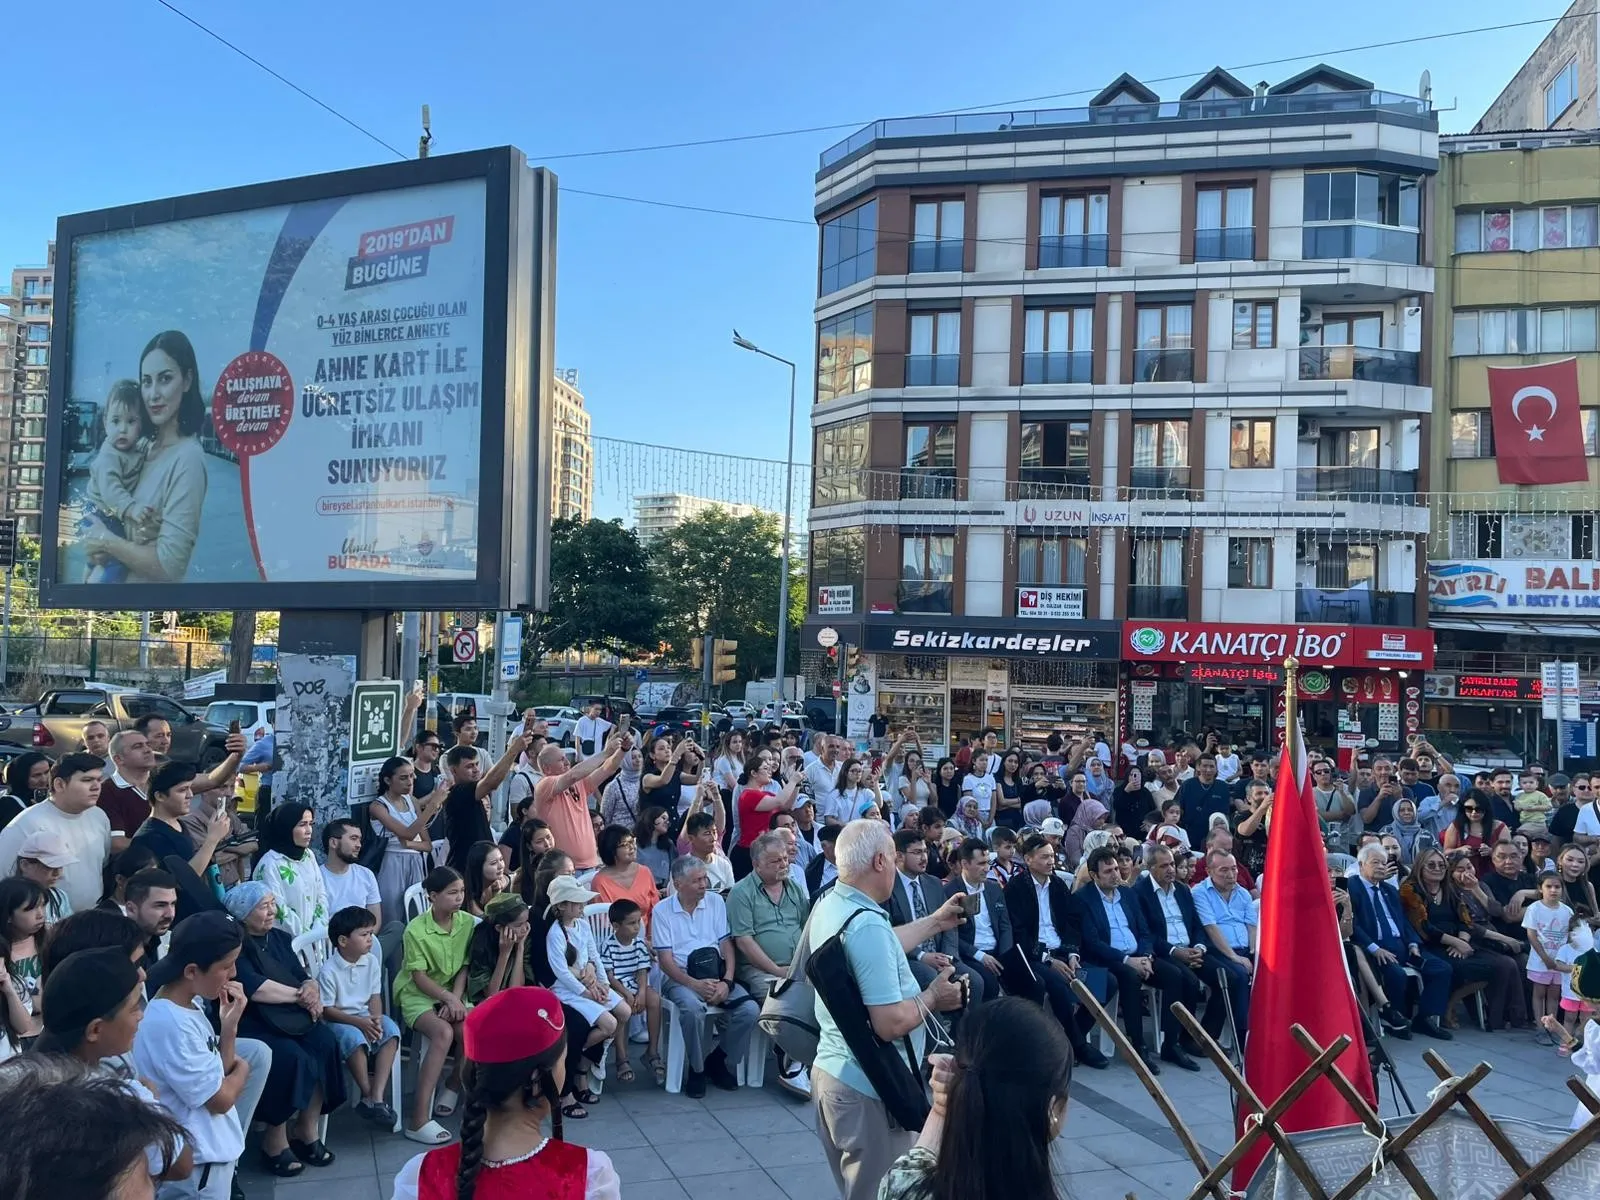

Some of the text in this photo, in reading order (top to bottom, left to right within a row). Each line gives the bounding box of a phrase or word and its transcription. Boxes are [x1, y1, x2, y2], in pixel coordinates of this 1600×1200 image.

[365, 222, 447, 255] 2019'DAN
[352, 255, 423, 285] BUGÜNE
[317, 301, 468, 328] 0-4 YAŞ ARASI ÇOCUĞU OLAN
[332, 322, 450, 346] YÜZ BİNLERCE ANNEYE
[314, 342, 468, 383] ANNE KART İLE
[226, 375, 282, 394] ÇALIŞMAYA
[237, 391, 270, 404] devam
[302, 382, 479, 418] ÜCRETSİZ ULAŞIM
[225, 404, 281, 421] ÜRETMEYE
[236, 420, 269, 433] devam
[351, 418, 424, 450] İMKANI
[328, 454, 447, 485] SUNUYORUZ
[1044, 510, 1082, 521] UZUN
[1092, 511, 1127, 525] İNŞAAT
[328, 554, 391, 570] BURADA
[1041, 590, 1053, 602] DİŞ
[893, 629, 1091, 654] Sekizkardeşler
[1170, 628, 1342, 662] KANATÇI İBO
